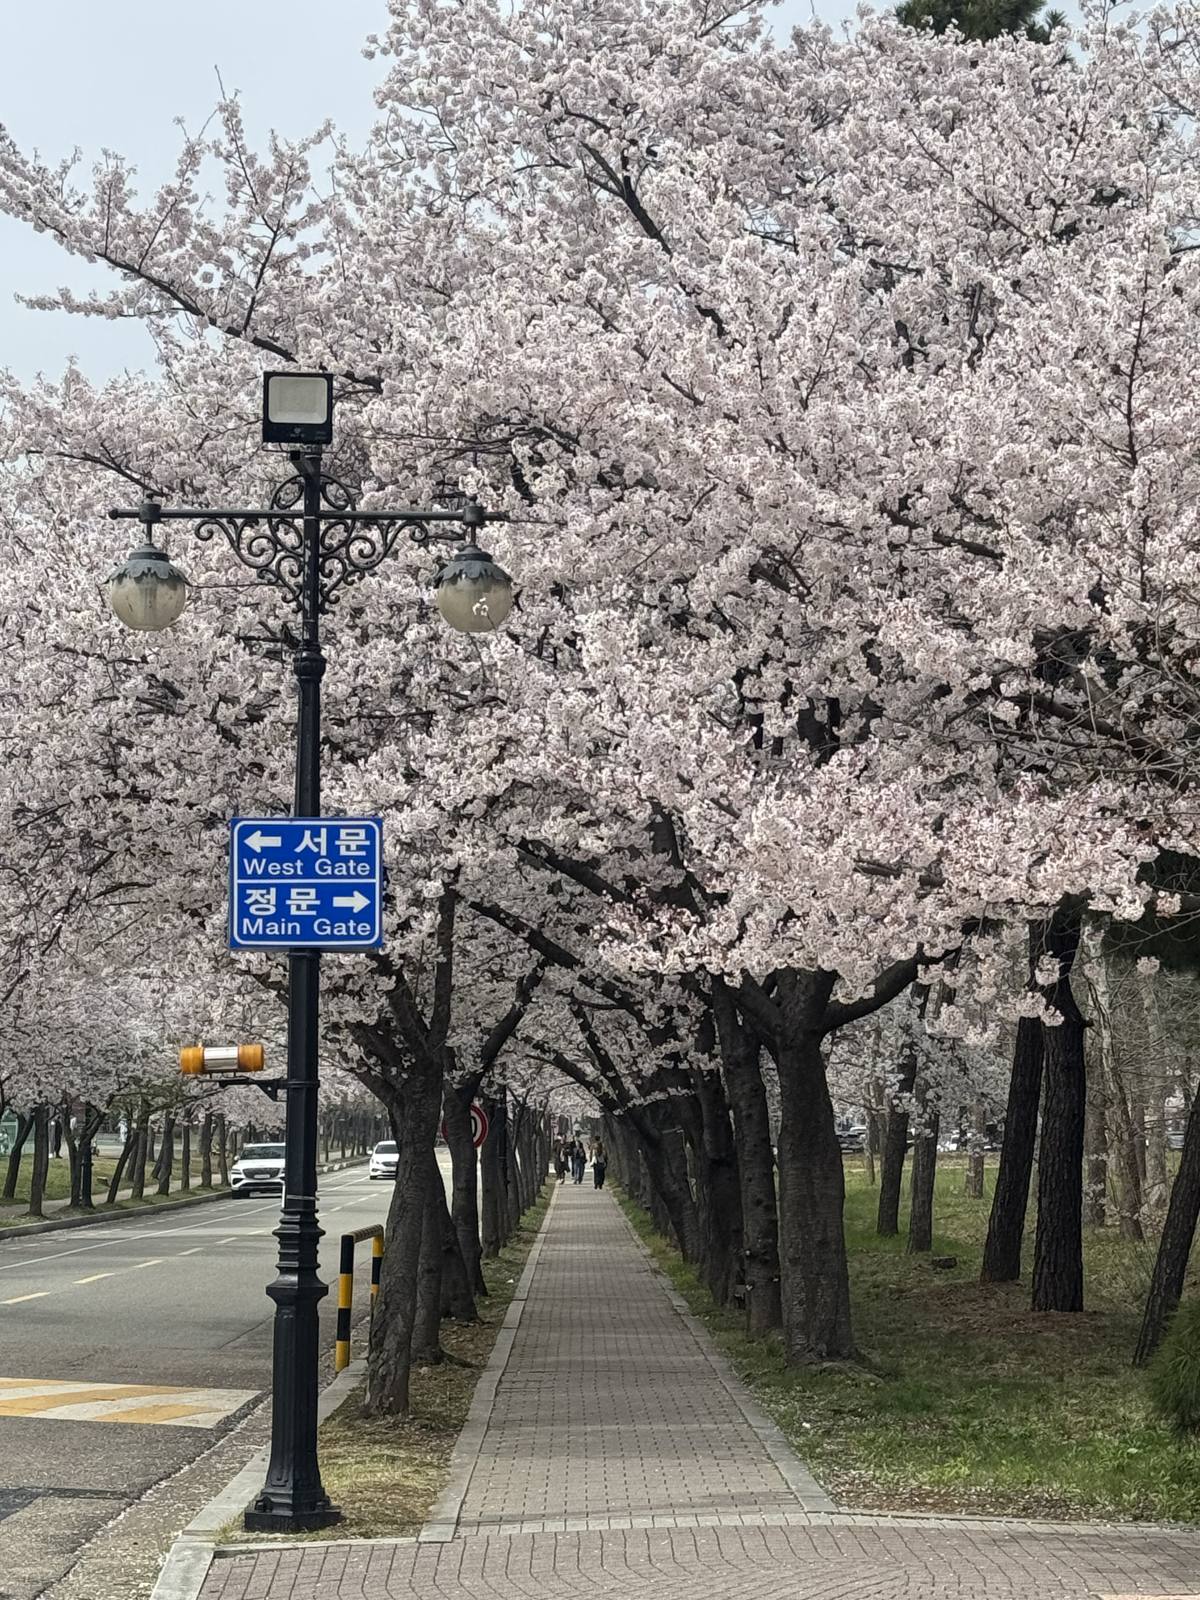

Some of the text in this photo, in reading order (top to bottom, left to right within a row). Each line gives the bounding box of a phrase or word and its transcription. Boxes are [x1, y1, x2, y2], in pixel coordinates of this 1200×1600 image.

[294, 828, 370, 856] 서문
[243, 858, 371, 875] West Gate
[244, 887, 320, 915] 정문
[242, 918, 371, 935] Main Gate
